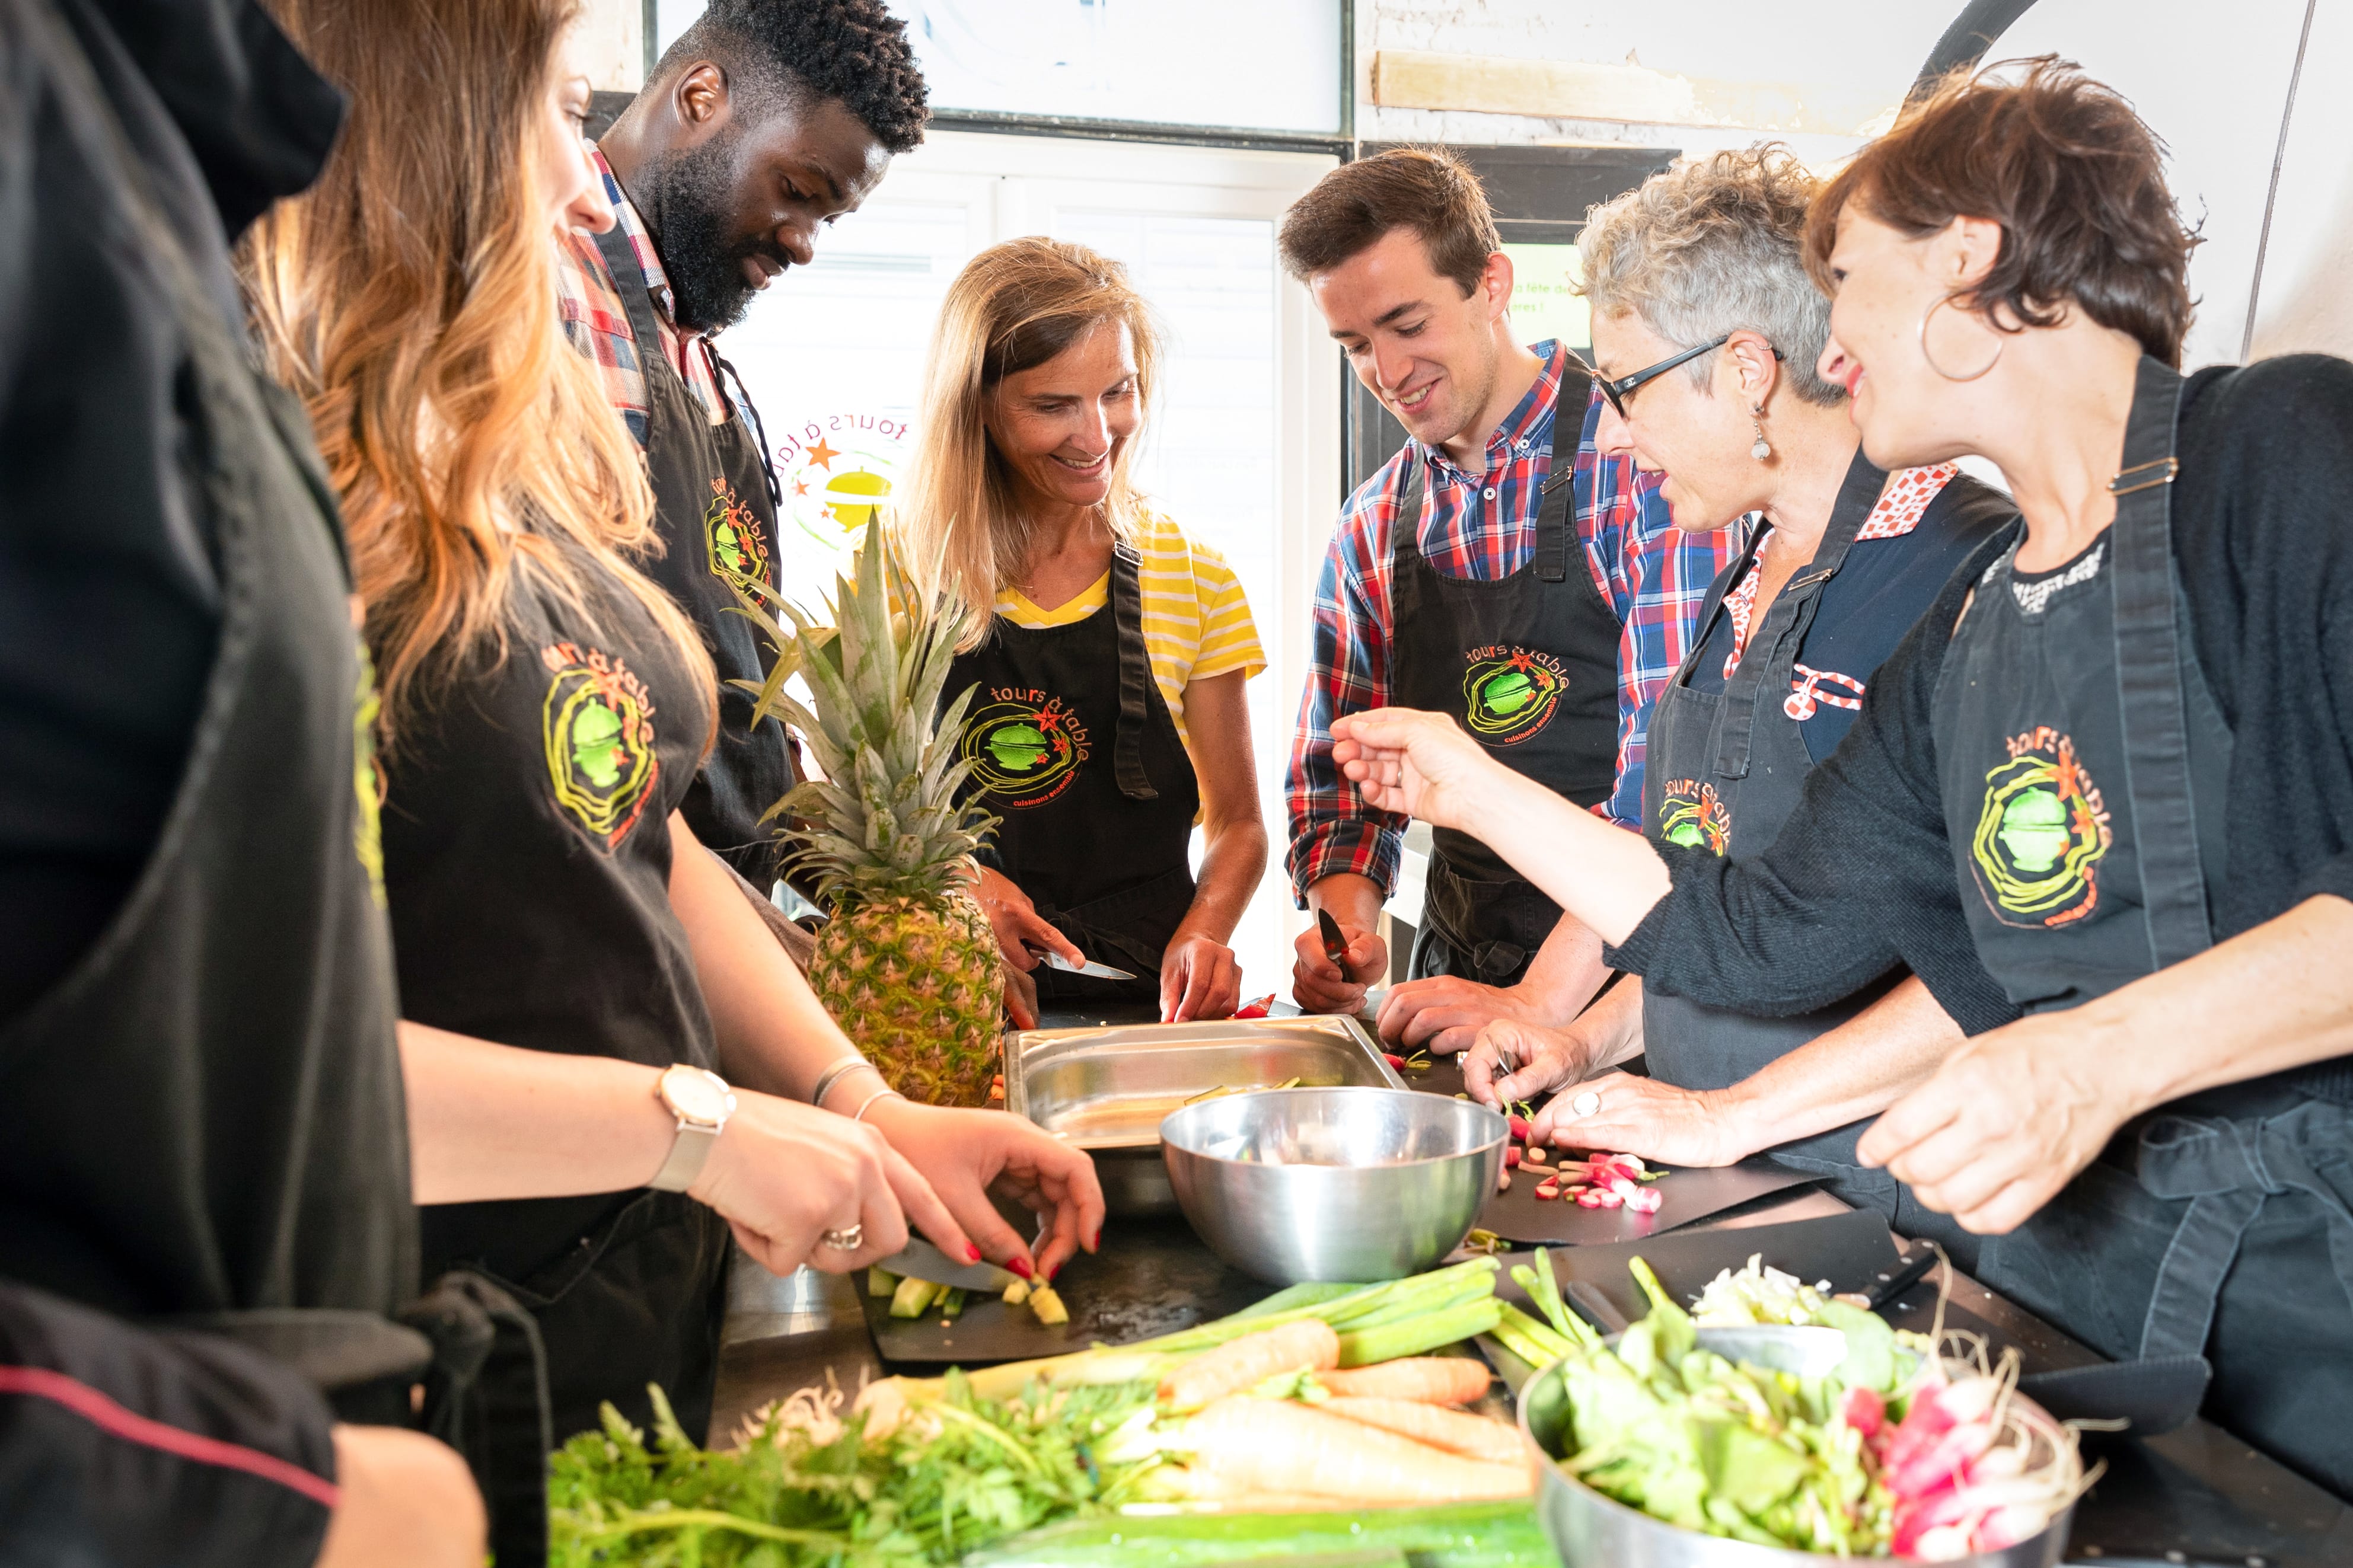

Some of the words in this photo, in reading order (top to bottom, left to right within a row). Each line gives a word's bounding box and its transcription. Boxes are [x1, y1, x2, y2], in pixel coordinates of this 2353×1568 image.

[739, 500, 769, 558] table
[1465, 645, 1508, 664] tours
[614, 657, 656, 742] table
[991, 687, 1047, 702] tours
[1048, 696, 1063, 713] à
[1061, 708, 1092, 761] table
